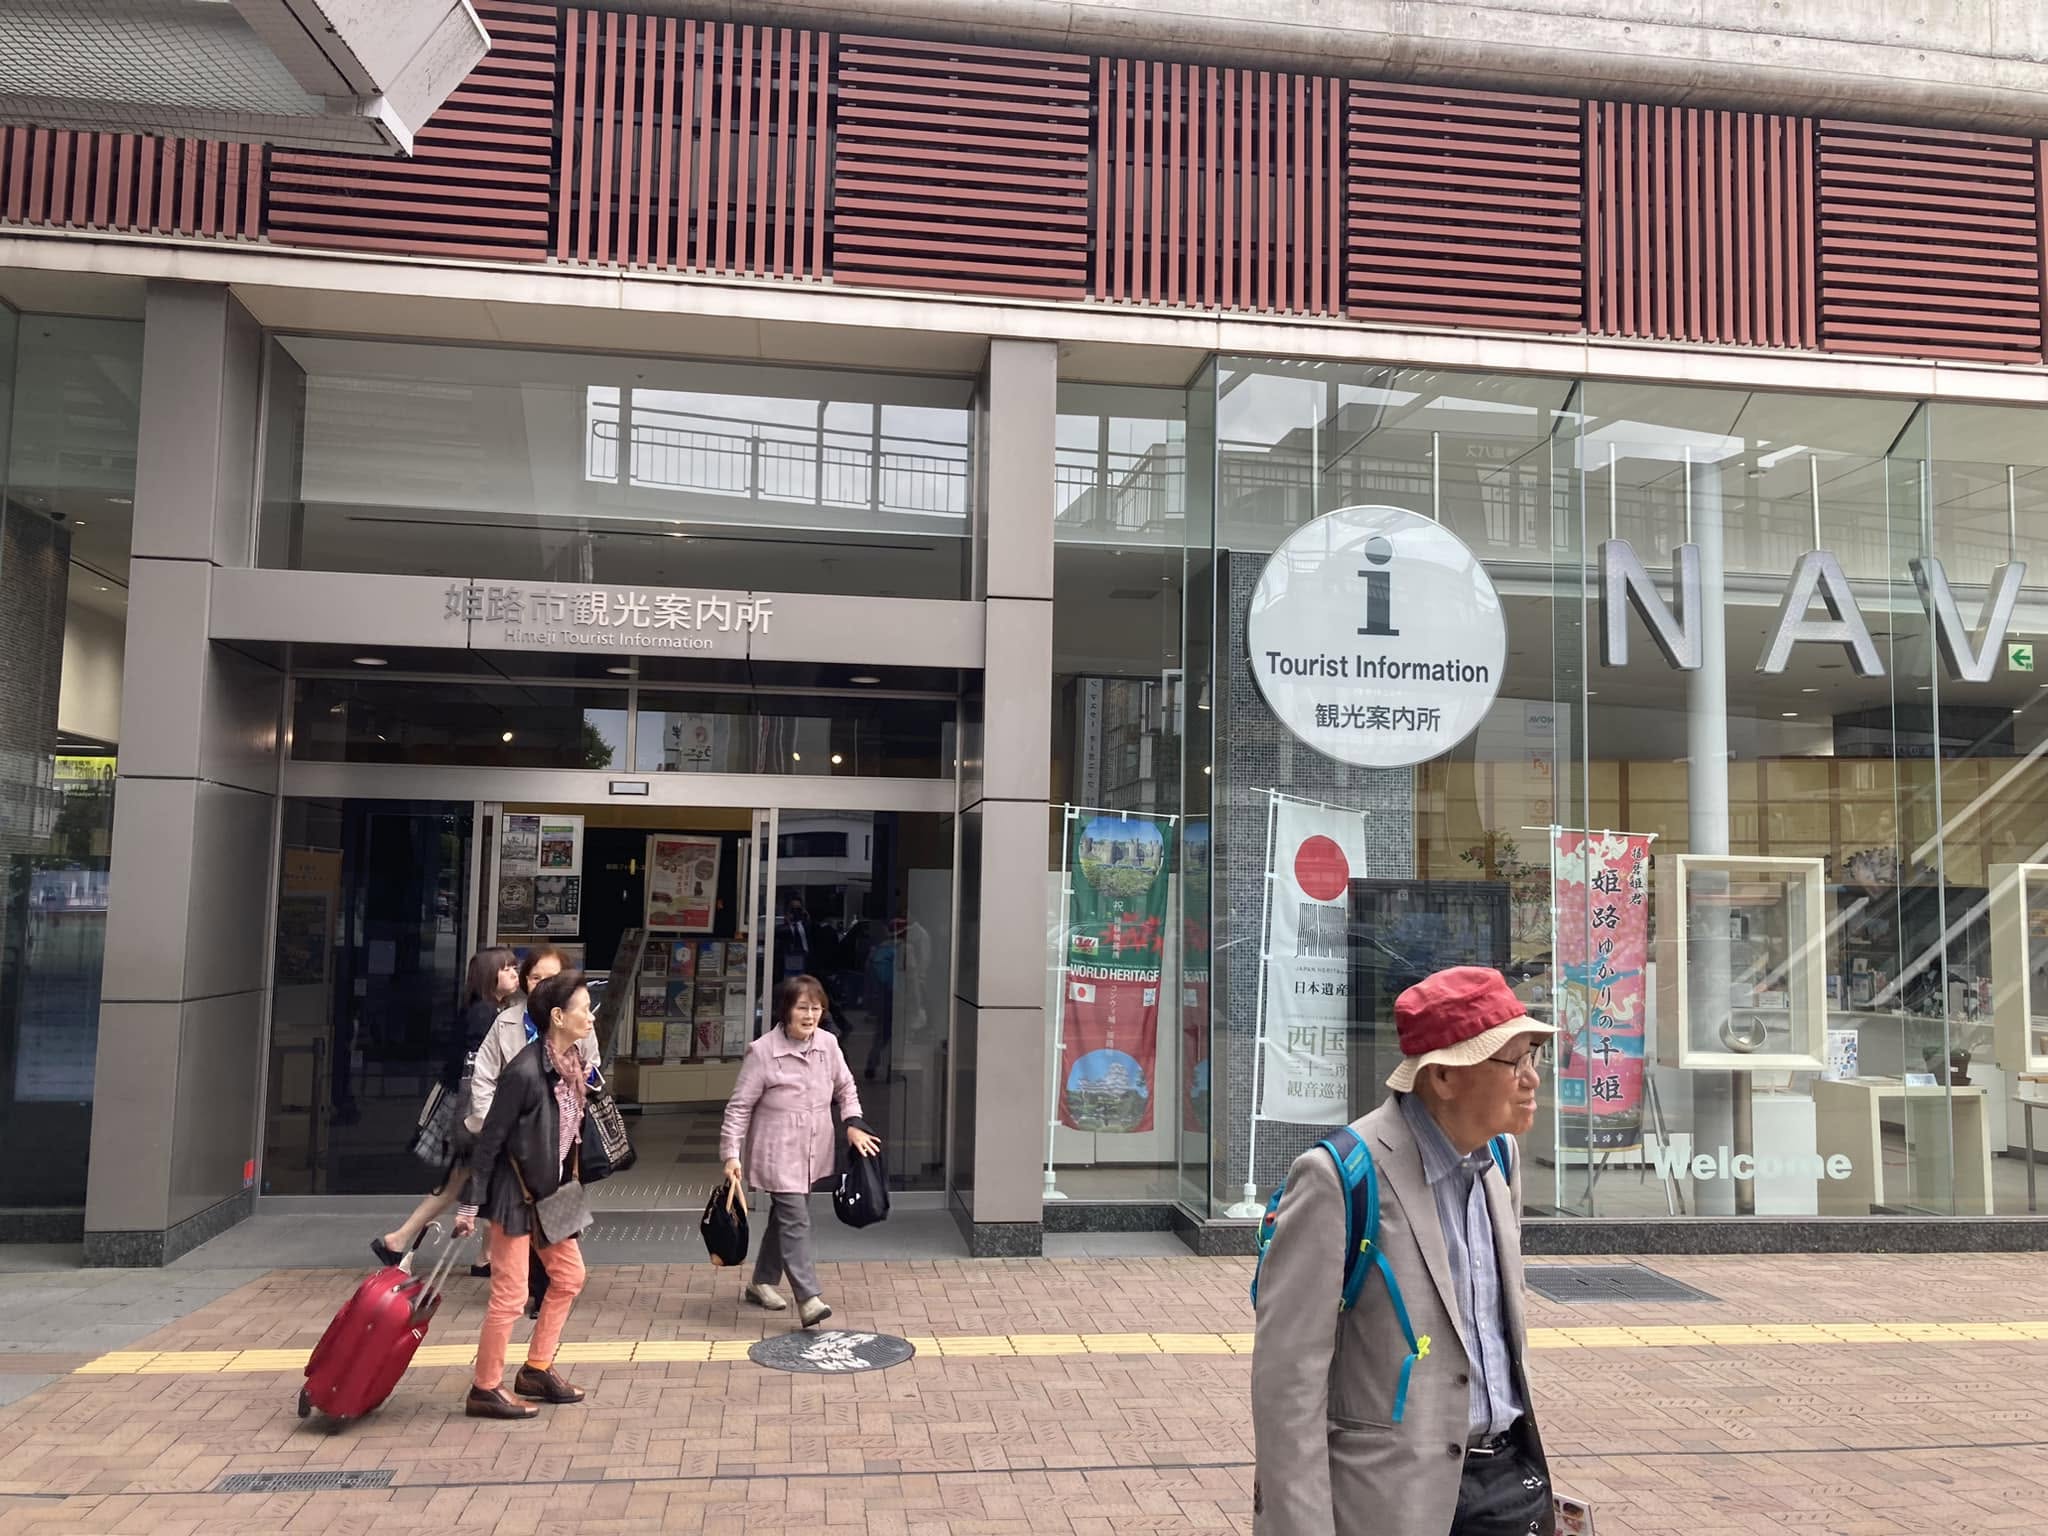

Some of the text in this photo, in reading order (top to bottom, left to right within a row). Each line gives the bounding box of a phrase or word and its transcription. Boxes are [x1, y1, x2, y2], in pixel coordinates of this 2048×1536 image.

[443, 583, 774, 635] 姫路市観光案内所
[504, 627, 713, 650] Himeji Tourist Information
[1266, 651, 1489, 683] Tourist Information
[1315, 702, 1441, 733] 観光案内所
[1070, 963, 1108, 980] WORLD
[1109, 968, 1160, 983] HERITAGE
[1295, 981, 1348, 996] 日本遺産
[1653, 1145, 1853, 1181] Welcome
